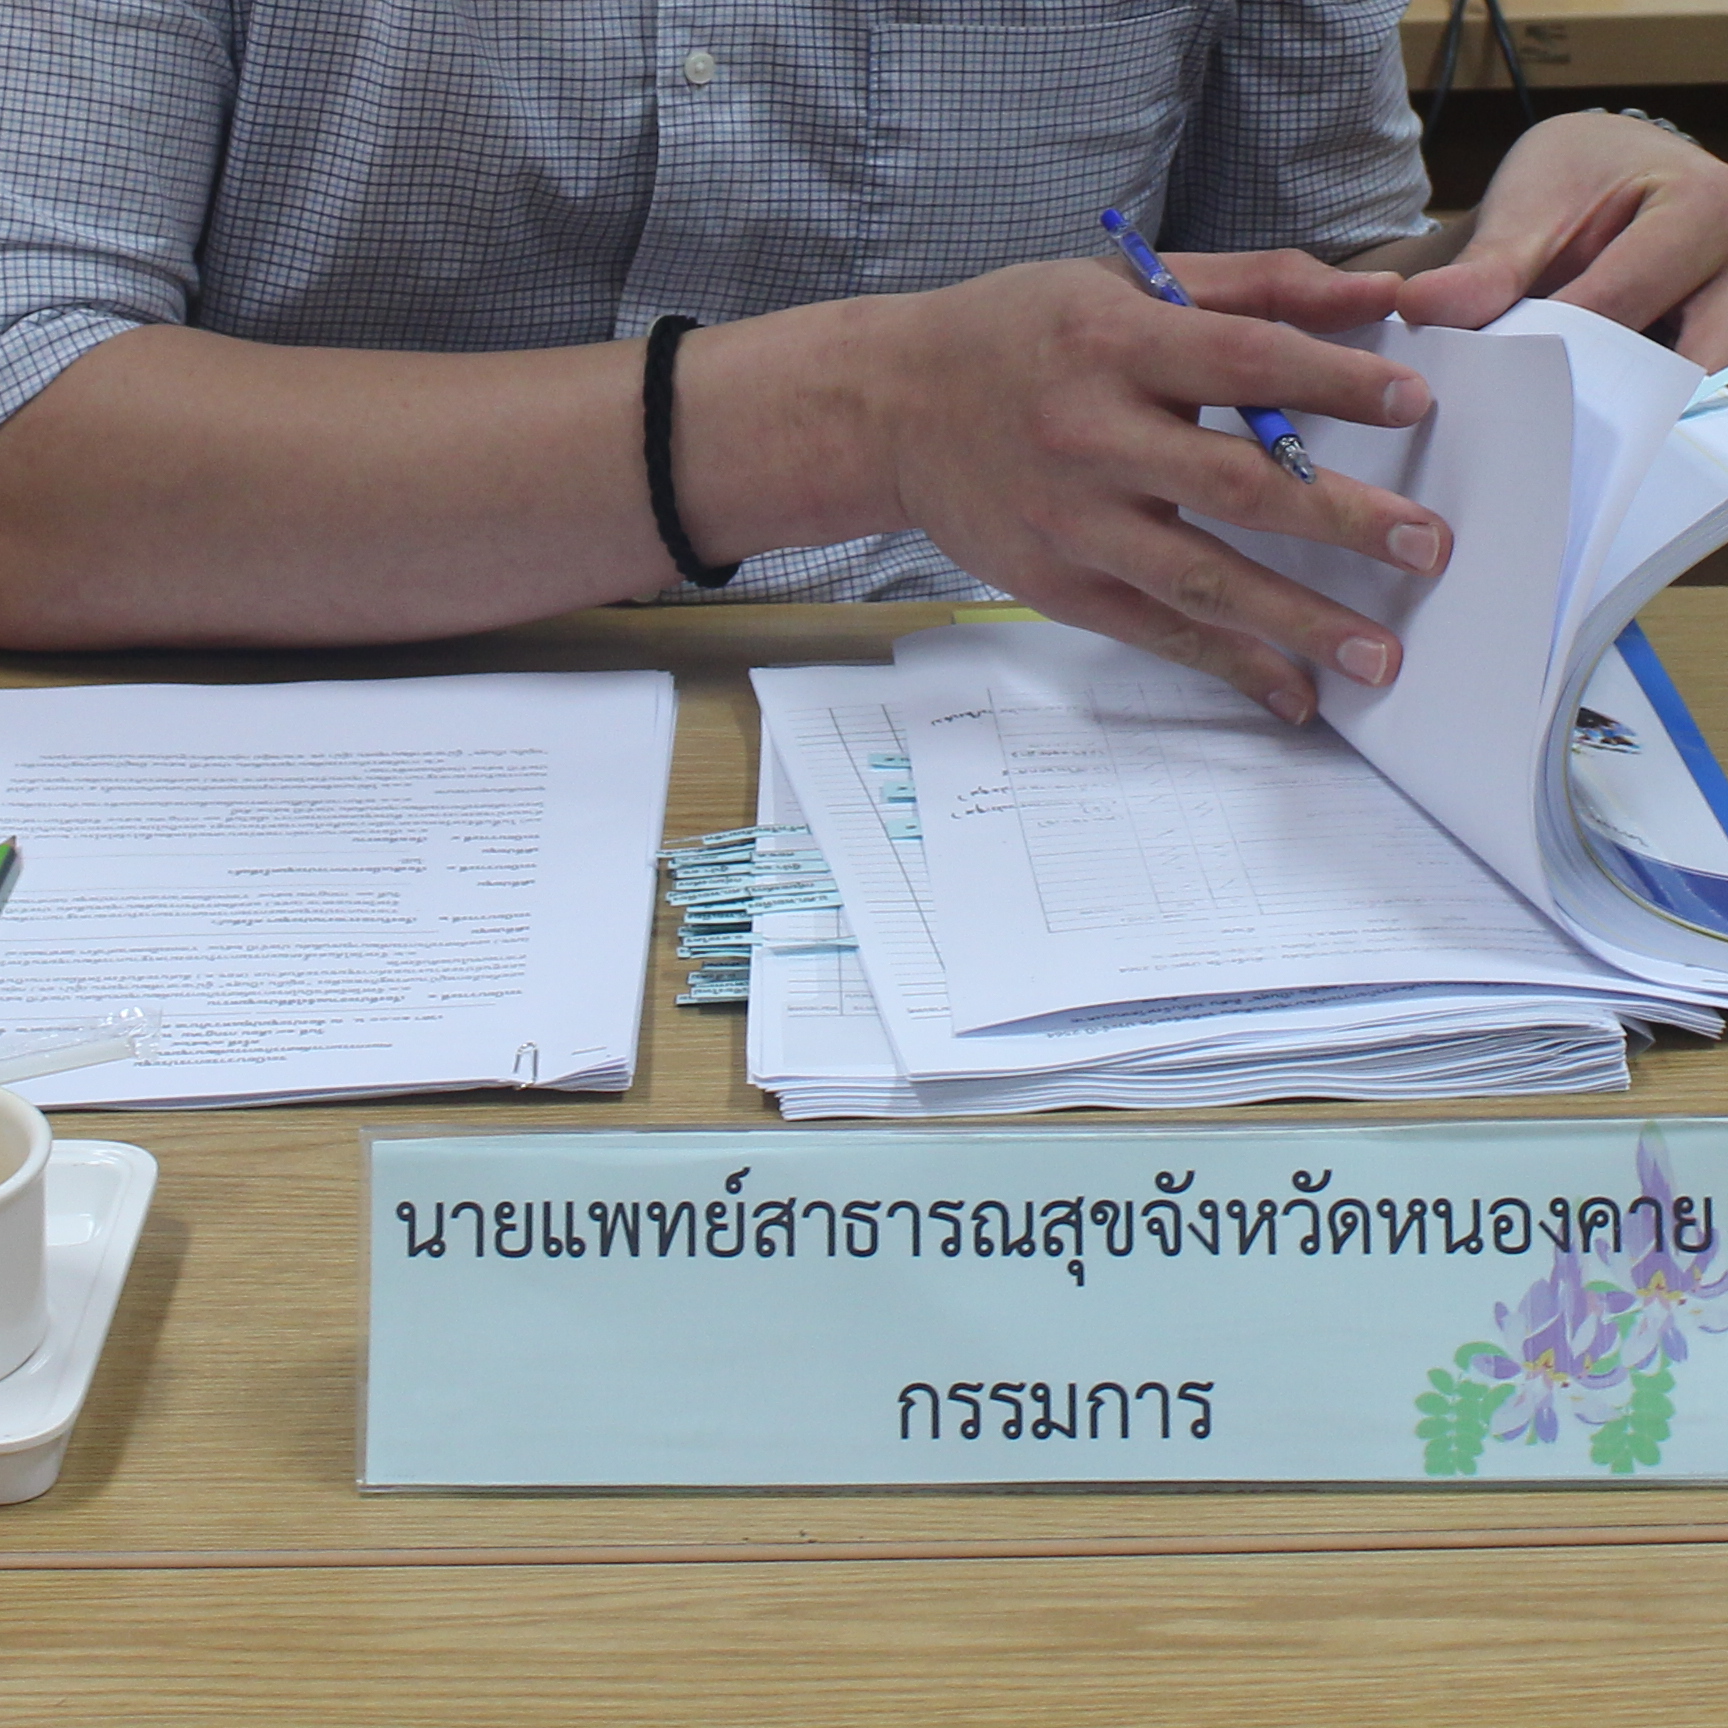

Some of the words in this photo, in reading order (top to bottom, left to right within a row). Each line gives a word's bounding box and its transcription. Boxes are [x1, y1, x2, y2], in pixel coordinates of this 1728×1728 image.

[395, 1166, 1716, 1288] นายแพทย์สาธารณสุขจังหวัดหนองคาย
[897, 1377, 1214, 1444] กรรมการ
